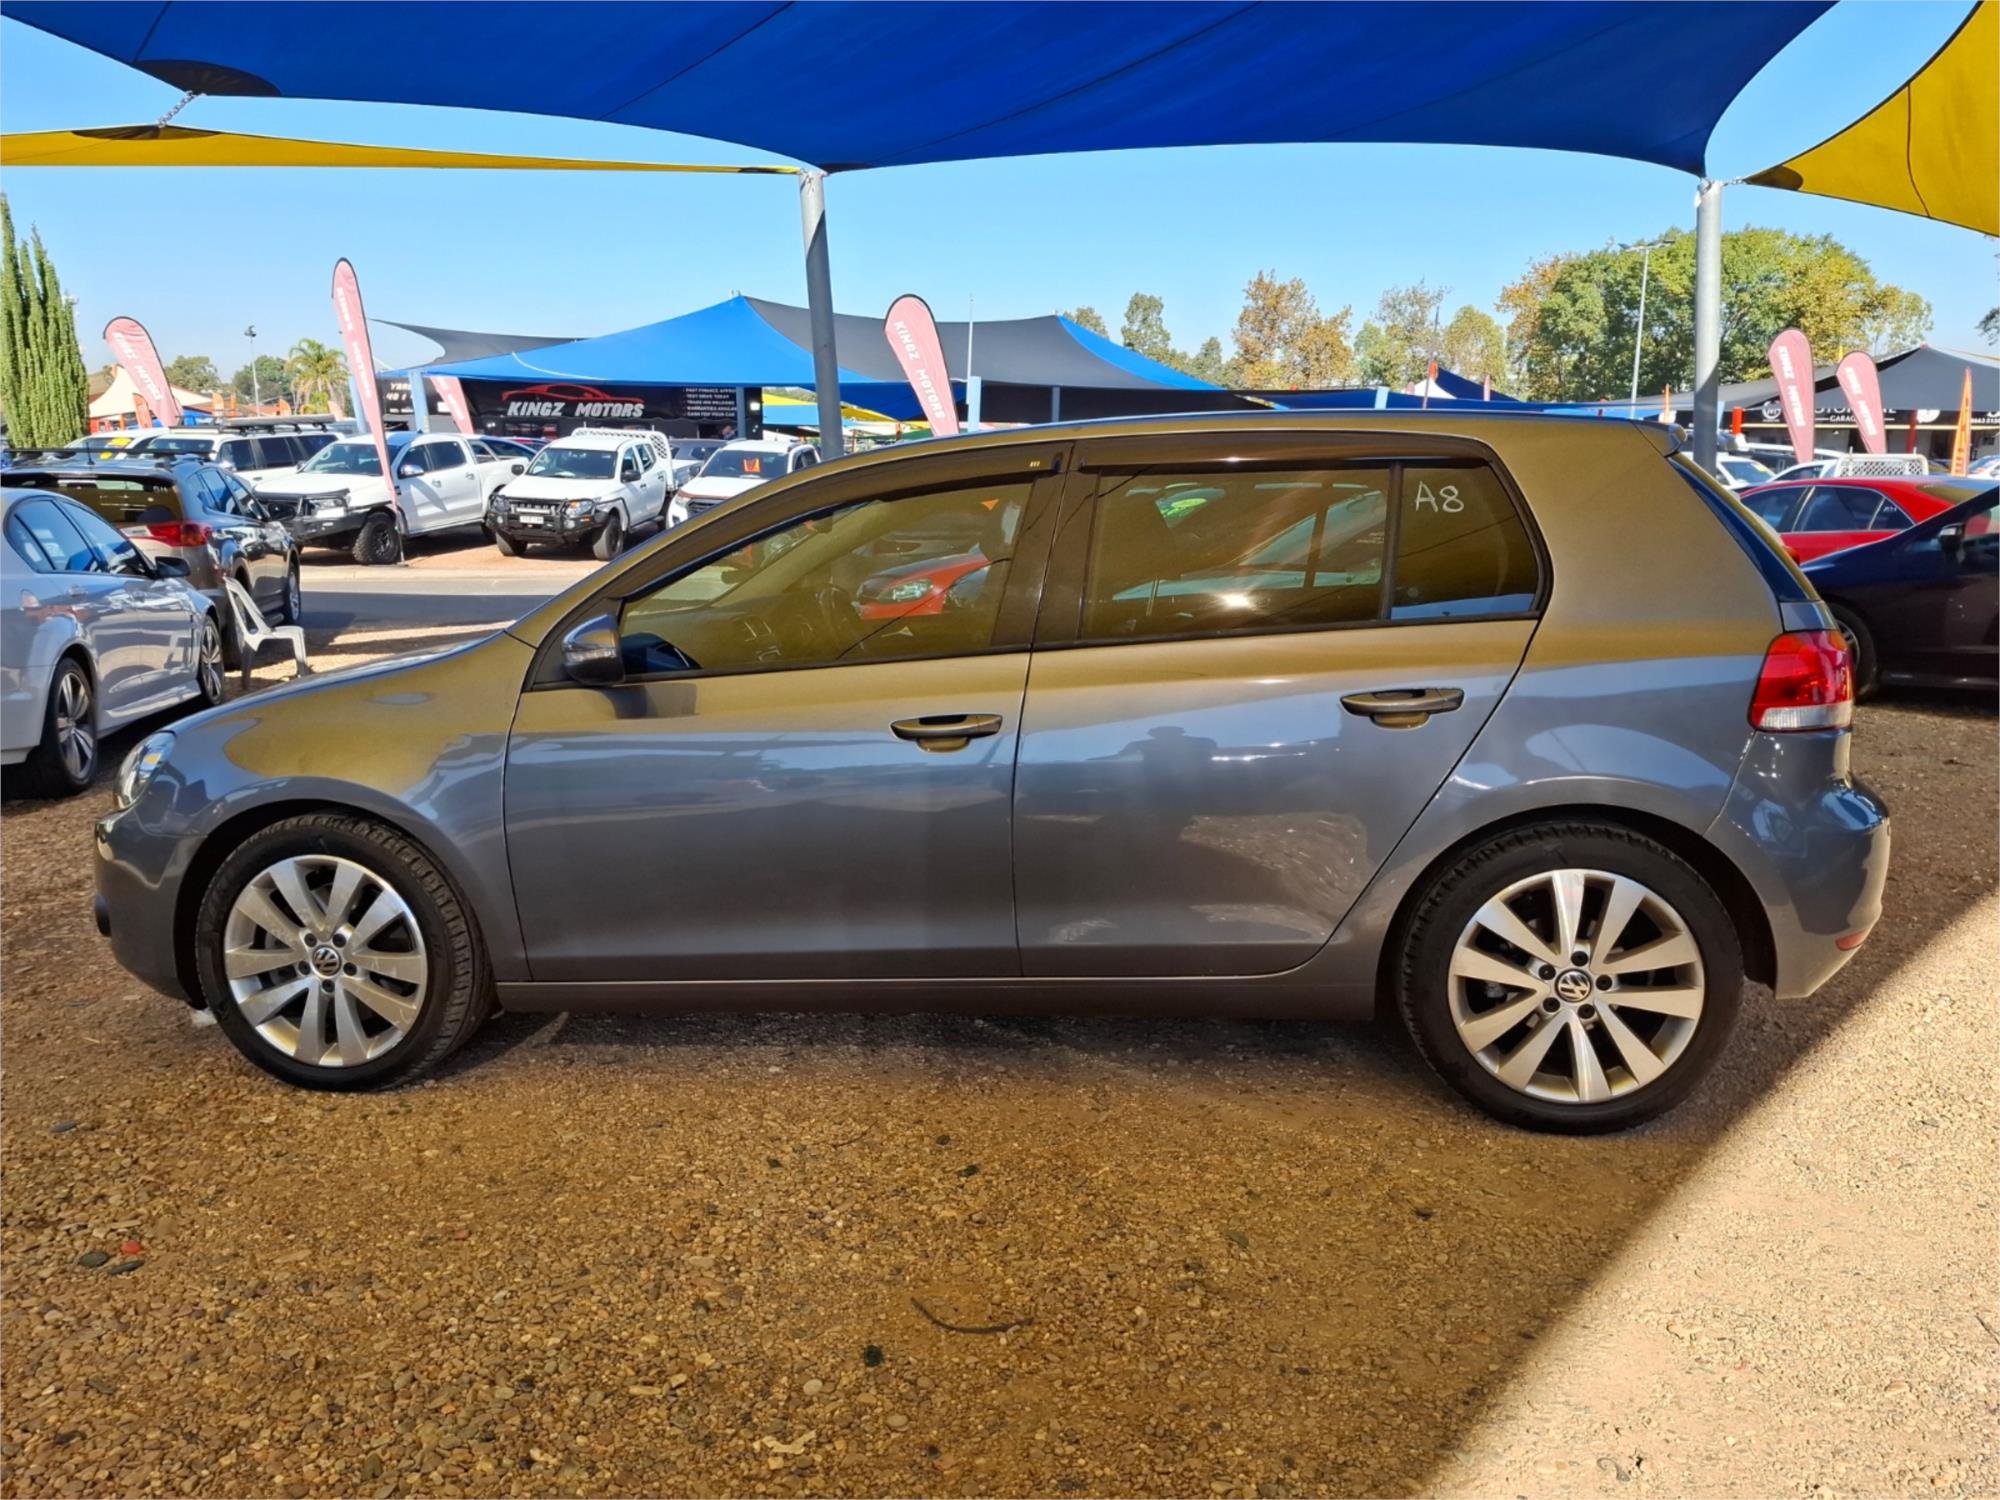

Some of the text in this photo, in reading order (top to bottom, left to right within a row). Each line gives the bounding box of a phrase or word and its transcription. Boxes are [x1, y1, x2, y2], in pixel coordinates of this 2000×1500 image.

[894, 320, 945, 419] KINGZ MOTORS
[507, 401, 645, 418] KINGZ MOTORS
[1829, 414, 1857, 422] GARAG
[1415, 480, 1465, 513] A8
